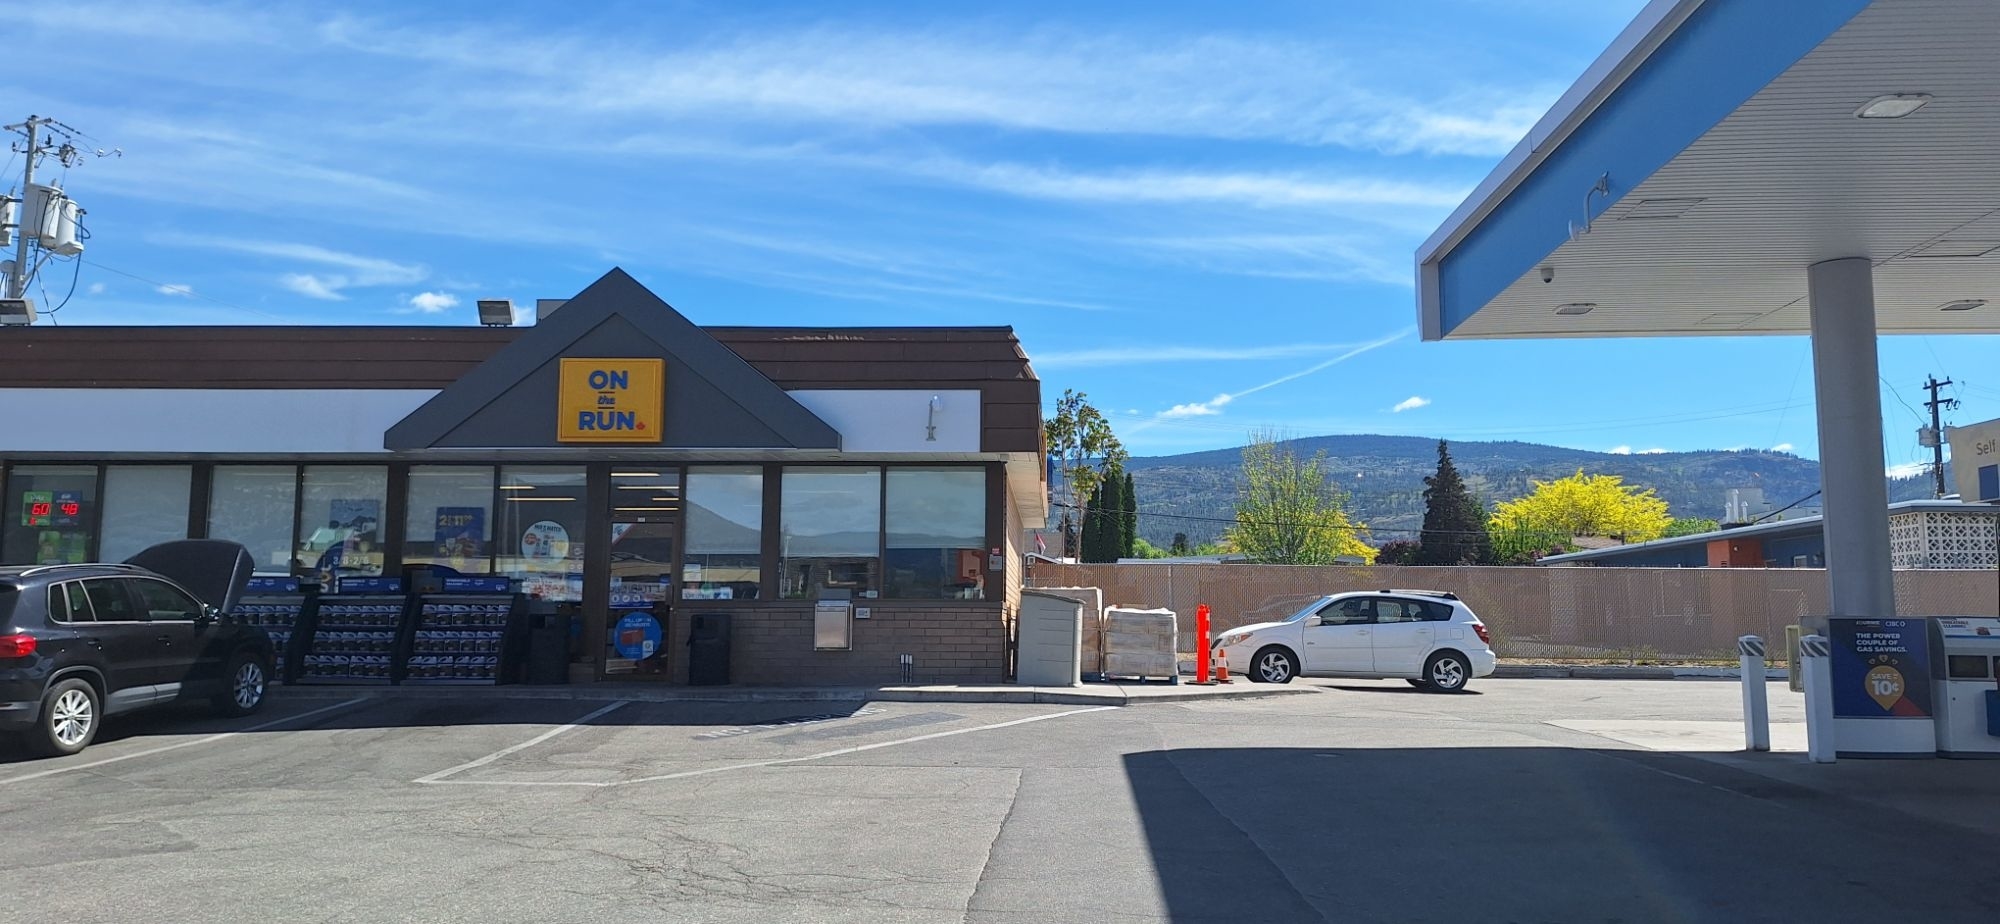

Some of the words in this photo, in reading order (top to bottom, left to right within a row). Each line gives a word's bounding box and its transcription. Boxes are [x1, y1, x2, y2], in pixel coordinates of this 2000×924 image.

[588, 370, 628, 390] ON
[597, 395, 616, 405] the
[578, 411, 635, 431] RUN
[1976, 440, 1996, 456] Self
[31, 503, 51, 516] 60
[60, 503, 79, 515] 48
[1871, 680, 1900, 696] 10¢
